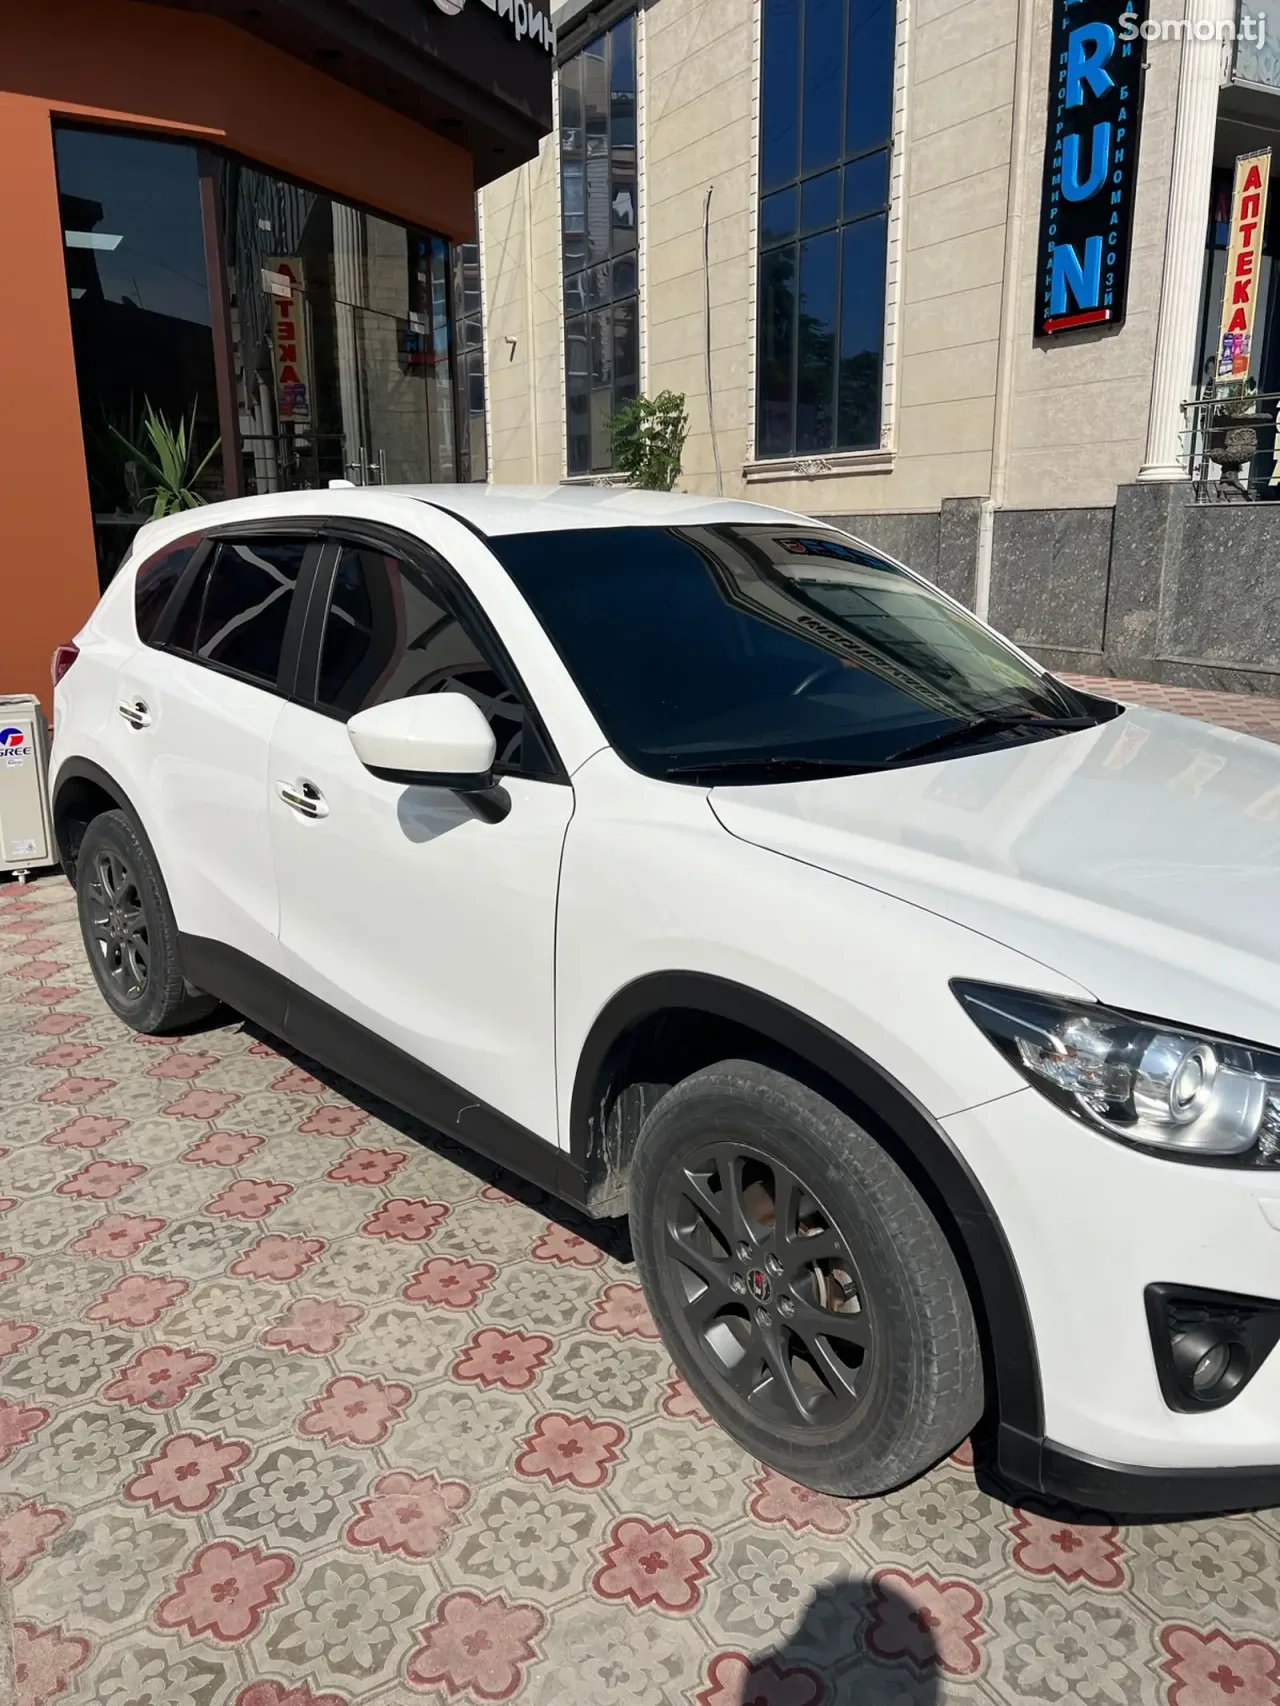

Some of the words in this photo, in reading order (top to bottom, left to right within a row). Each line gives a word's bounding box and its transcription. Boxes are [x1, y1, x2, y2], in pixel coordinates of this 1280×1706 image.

[481, 0, 557, 56] ирин
[1050, 0, 1116, 314] RUN
[1228, 165, 1262, 332] АПТЕКА
